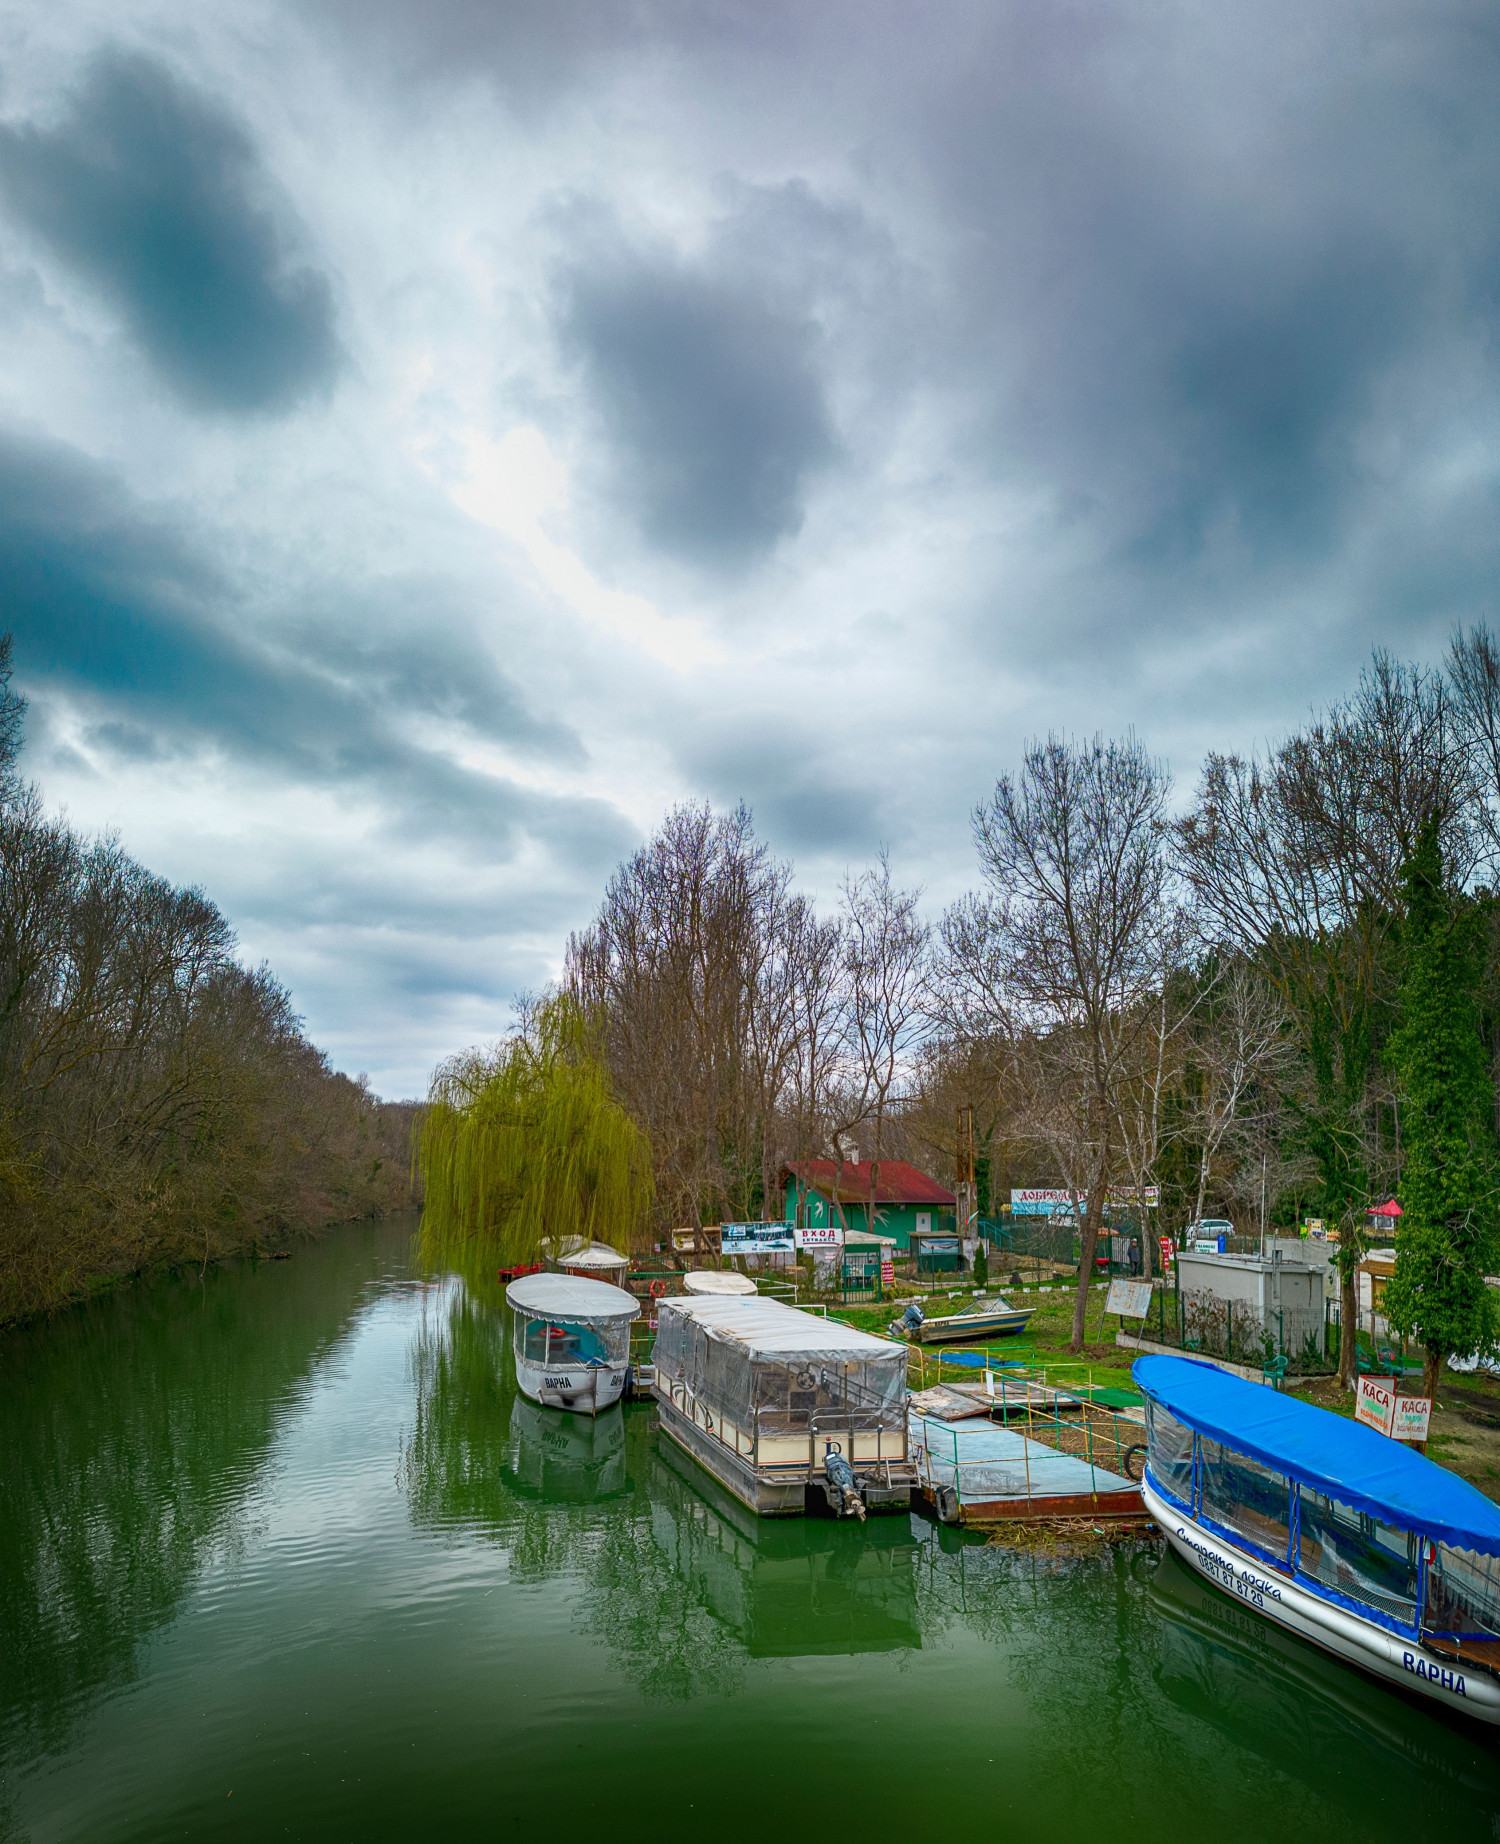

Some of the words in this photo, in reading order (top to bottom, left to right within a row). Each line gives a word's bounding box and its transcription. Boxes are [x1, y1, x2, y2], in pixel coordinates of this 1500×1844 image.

[802, 1230, 836, 1238] ВХОД
[544, 1377, 572, 1389] ВАРНА
[1362, 1382, 1389, 1408] КАСА
[1401, 1400, 1428, 1414] КАСА
[1177, 1528, 1234, 1574] Старата
[1241, 1571, 1282, 1601] лодка
[1198, 1554, 1220, 1579] 0887
[1222, 1570, 1234, 1588] 87
[1236, 1579, 1248, 1598] 87
[1250, 1590, 1264, 1607] 29
[1403, 1651, 1467, 1697] ВАРНА
